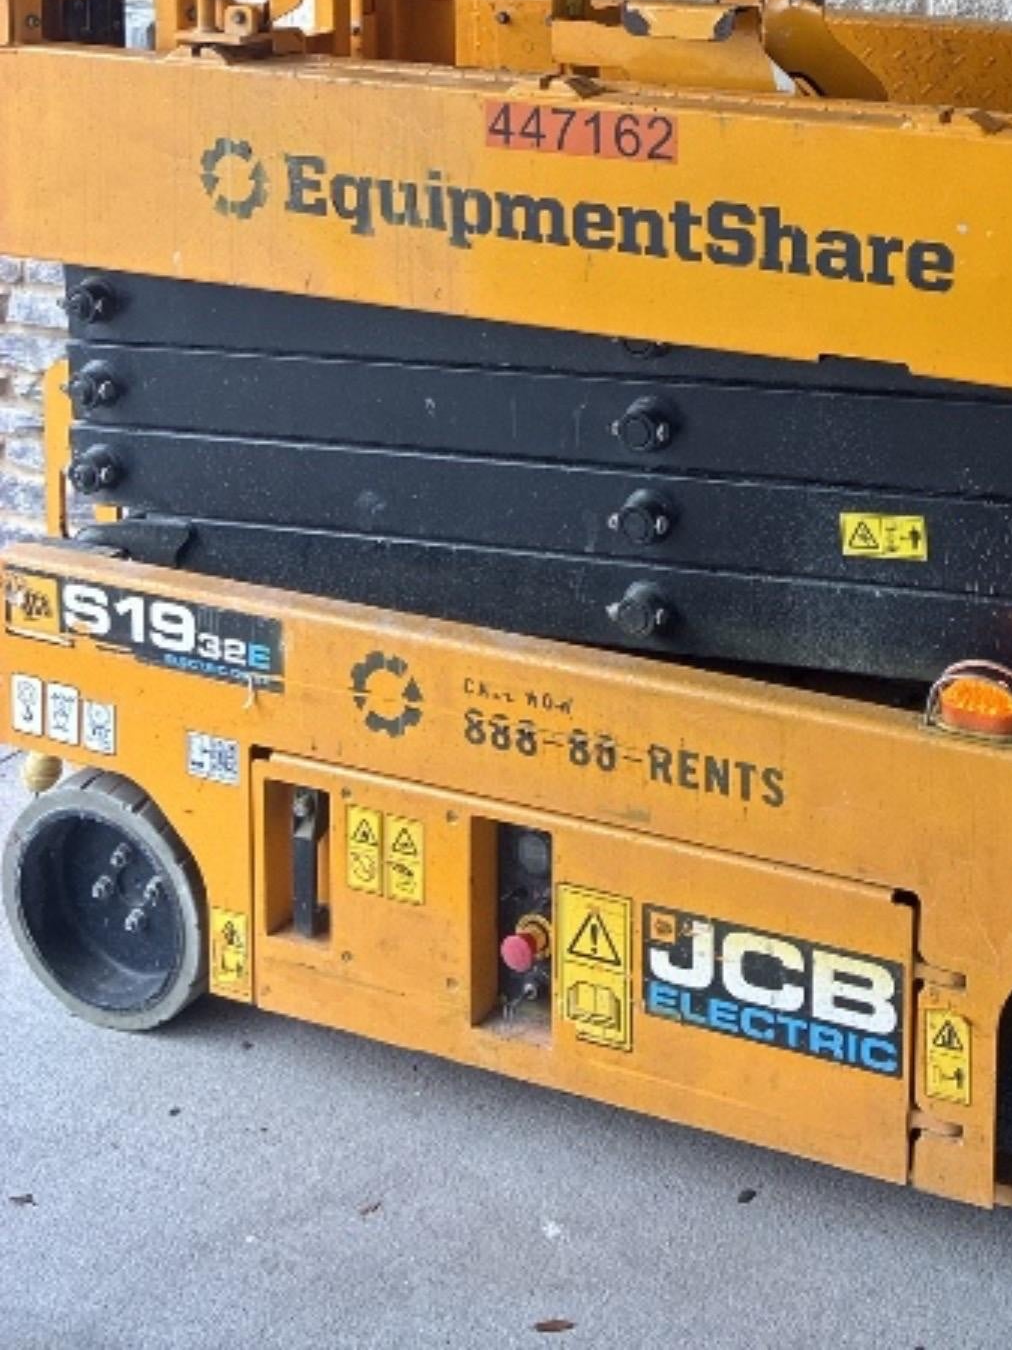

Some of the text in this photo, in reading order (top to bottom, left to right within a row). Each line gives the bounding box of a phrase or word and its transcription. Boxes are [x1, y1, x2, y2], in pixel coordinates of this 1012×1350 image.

[488, 102, 674, 161] 447162
[284, 152, 955, 294] EquipmentShare
[648, 981, 898, 1072] ELECTRIC
[650, 919, 898, 1033] JCB
